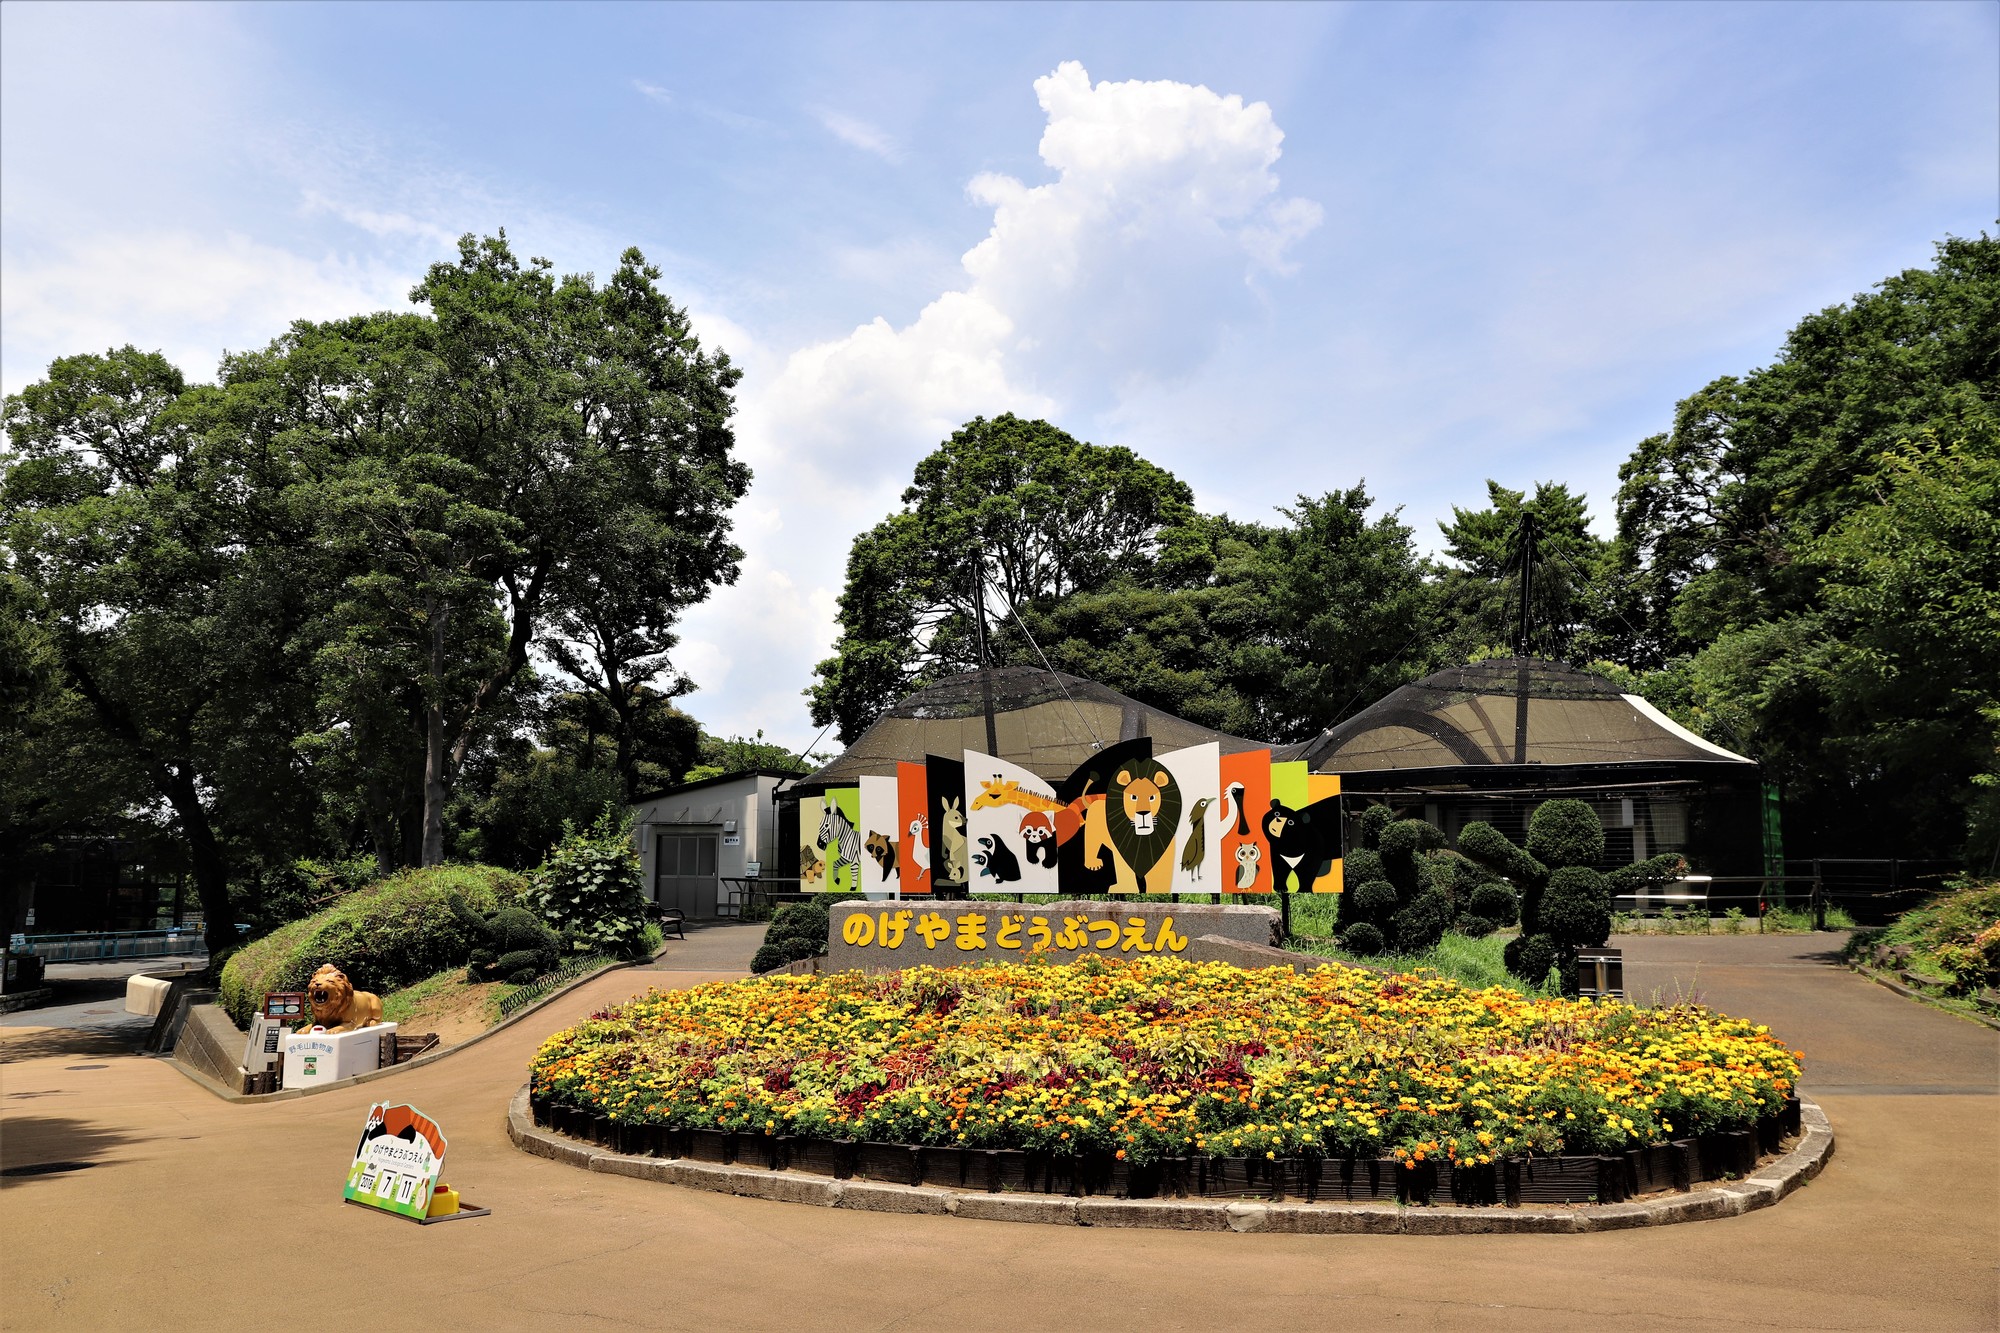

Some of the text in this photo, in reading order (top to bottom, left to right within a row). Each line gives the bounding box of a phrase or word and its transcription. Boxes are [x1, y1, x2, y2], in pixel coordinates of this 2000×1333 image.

[842, 909, 1189, 953] のげやまどうぶつえん
[373, 1144, 423, 1164] のげやまどうぶつえん
[360, 1176, 374, 1190] 2018
[382, 1176, 392, 1193] 7
[401, 1180, 412, 1199] 11
